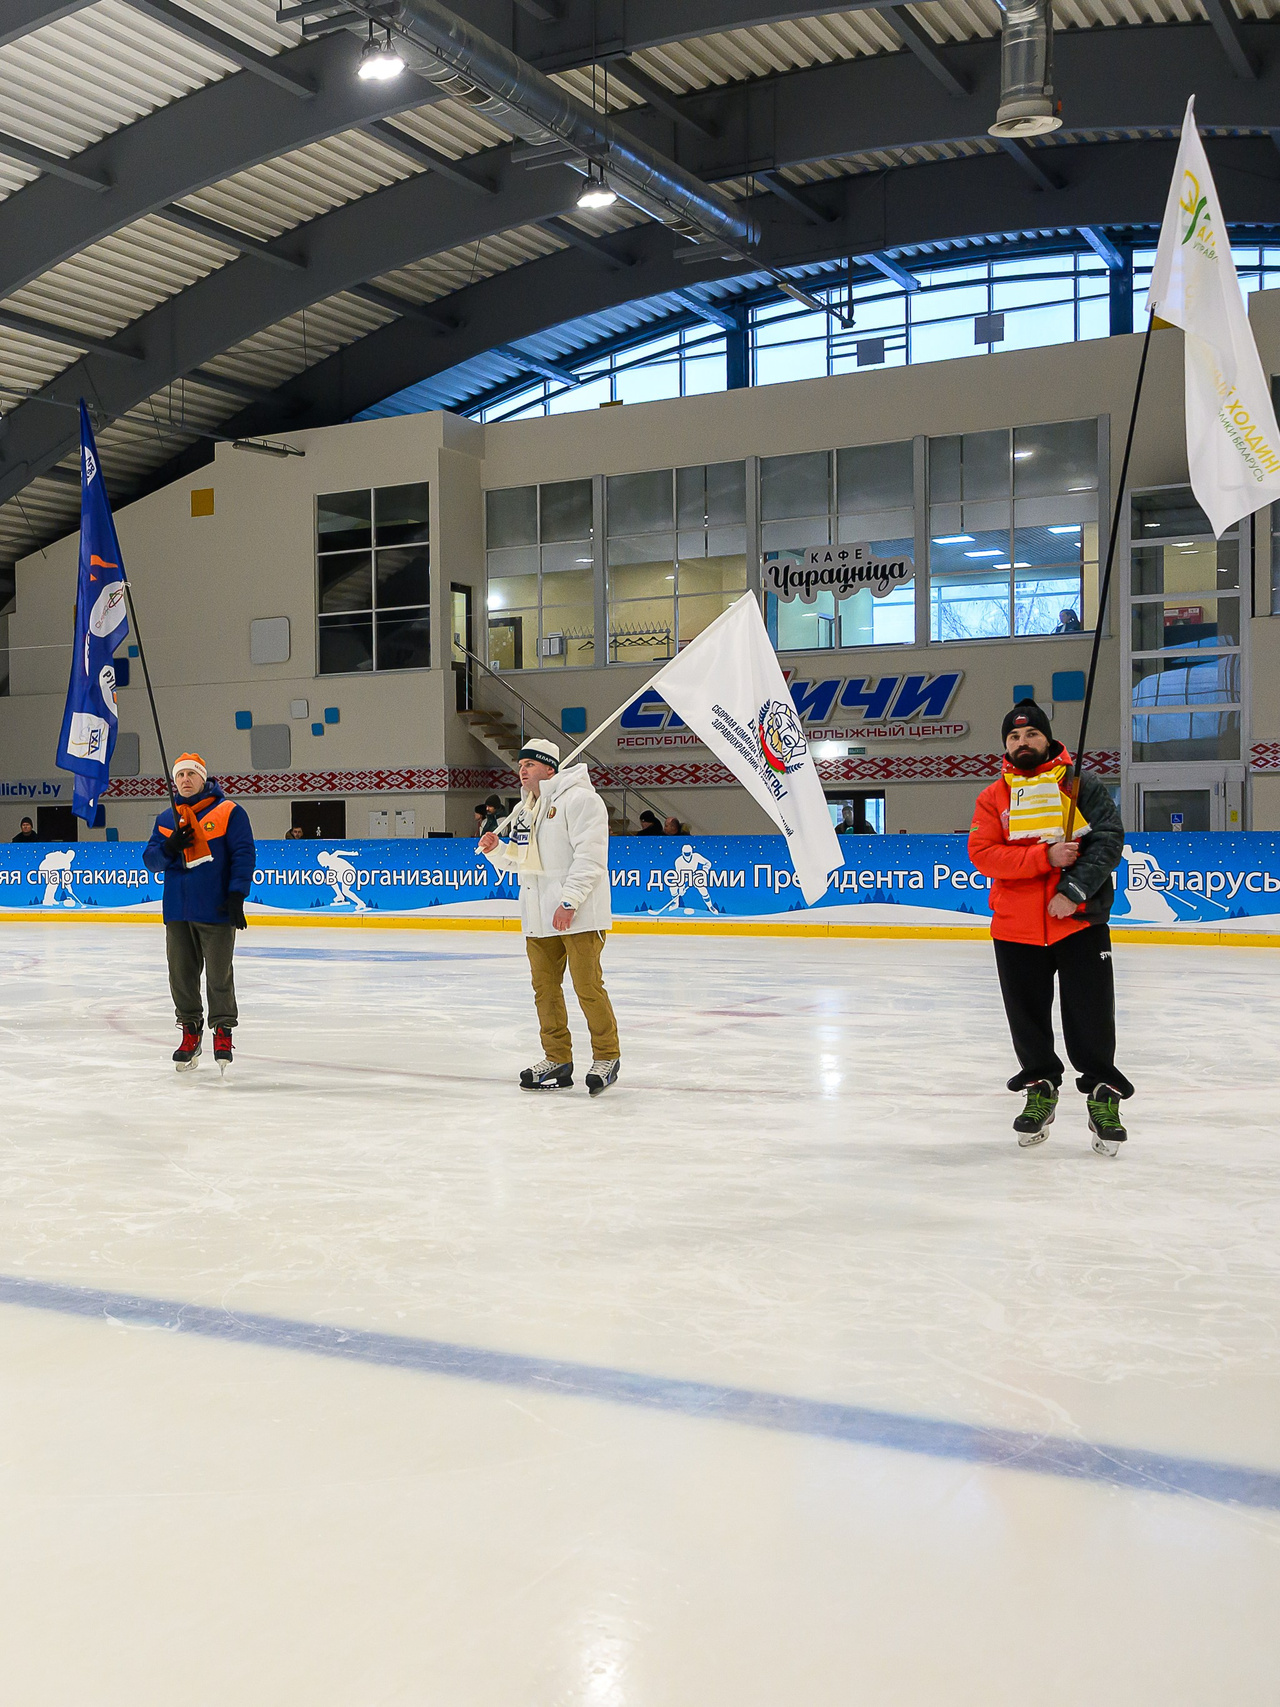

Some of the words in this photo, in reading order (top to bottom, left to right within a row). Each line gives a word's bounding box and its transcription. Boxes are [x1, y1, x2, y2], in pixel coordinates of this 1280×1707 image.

[1232, 436, 1265, 482] БЕЛАРУСЬ
[811, 549, 863, 564] КАФЕ
[768, 560, 889, 598] Чараўніца
[620, 669, 960, 729] СИЧИ
[617, 735, 704, 747] РЕСПУБЛИК
[806, 725, 902, 741] НОЛЫЖНЫЙ
[909, 724, 964, 738] ЦЕНТР
[711, 704, 738, 739] СБОРНАЯ
[26, 868, 148, 887] спартакиада
[251, 869, 338, 886] отников
[343, 864, 488, 887] организаций
[647, 869, 746, 891] делами
[753, 864, 924, 894] Преидента
[1128, 864, 1280, 900] Беларусь
